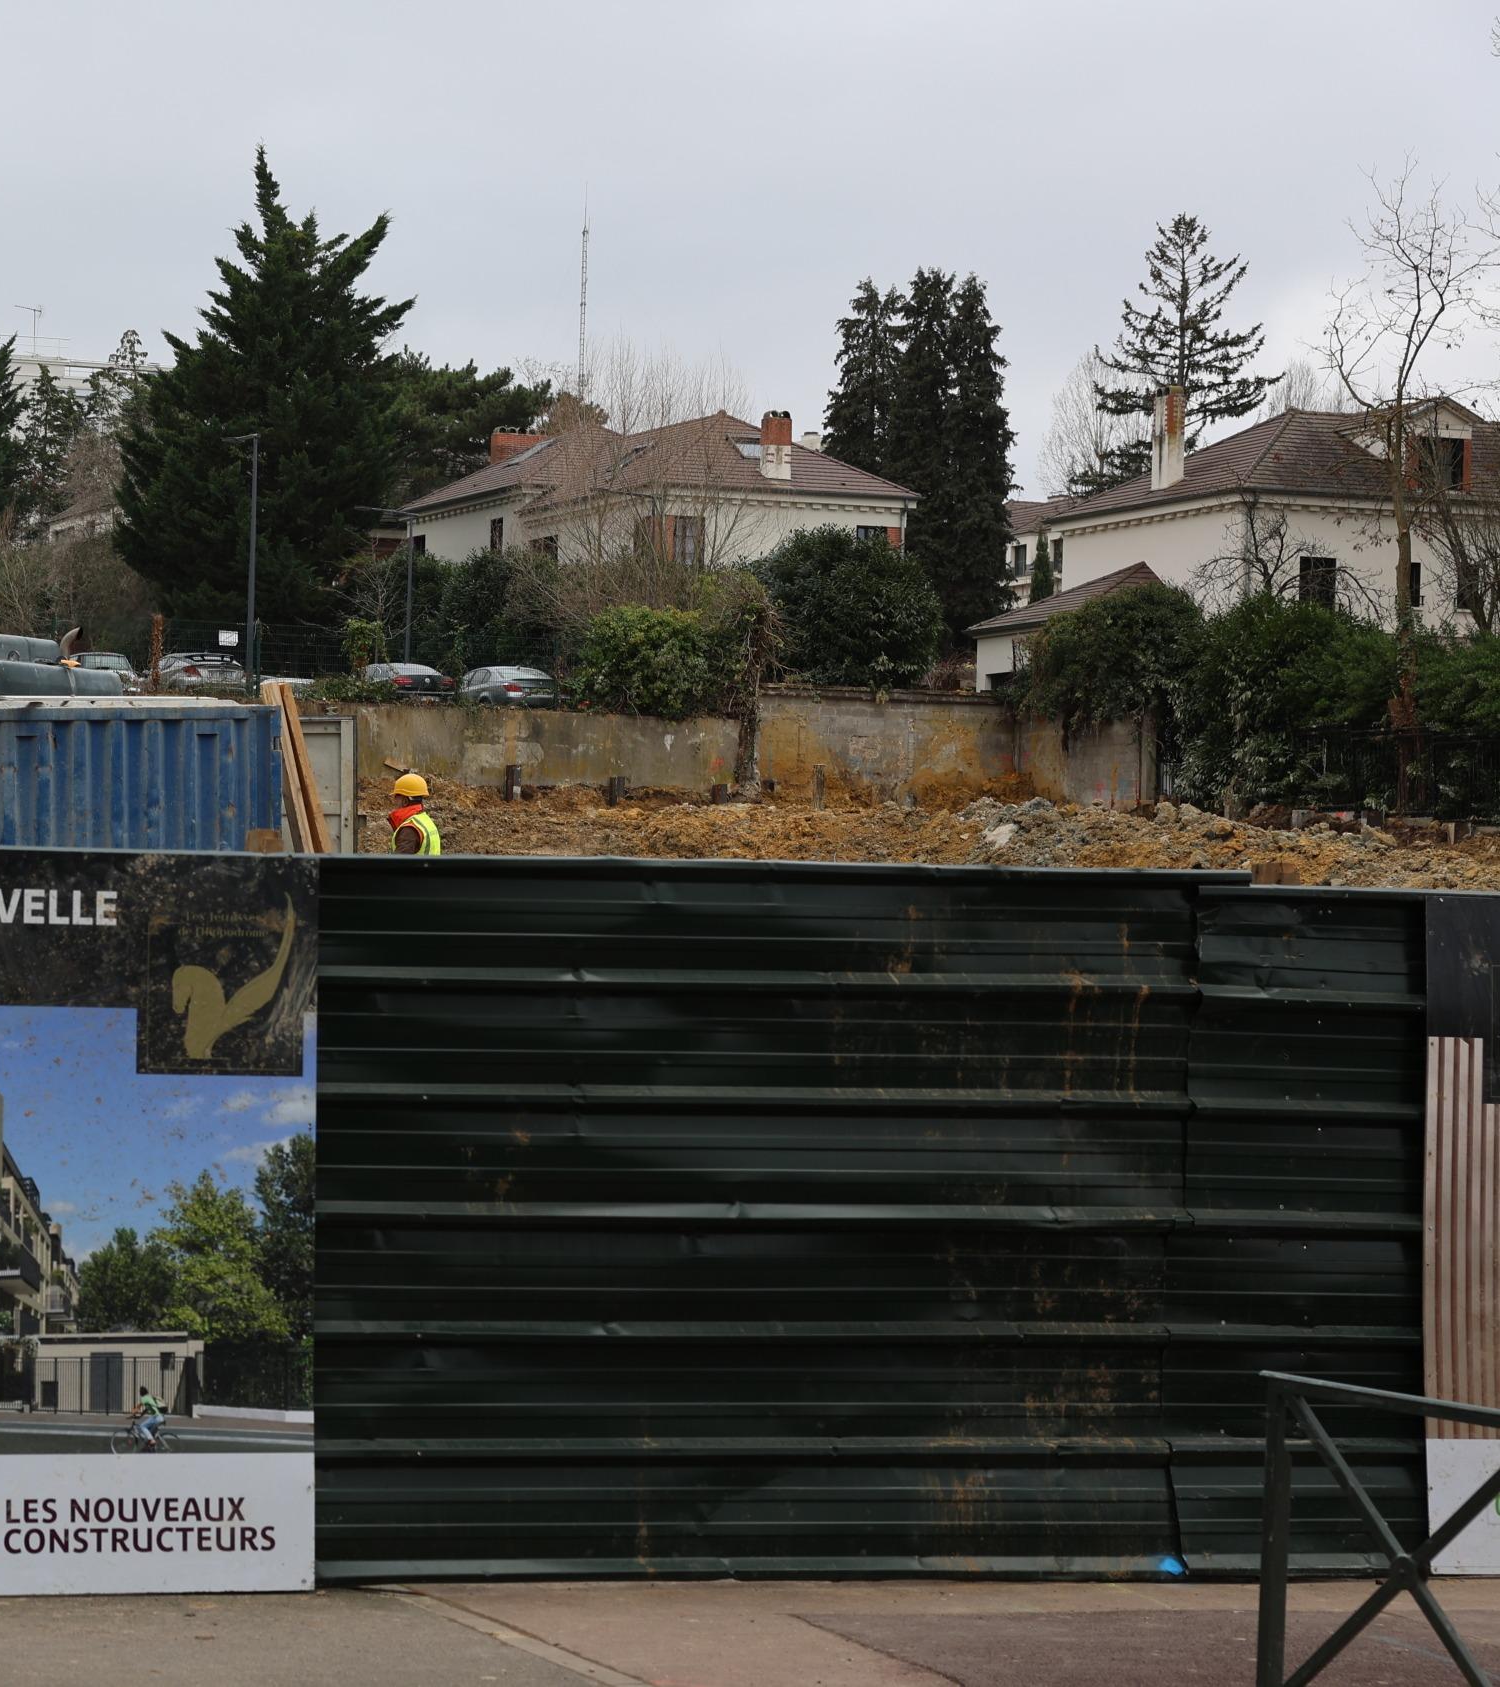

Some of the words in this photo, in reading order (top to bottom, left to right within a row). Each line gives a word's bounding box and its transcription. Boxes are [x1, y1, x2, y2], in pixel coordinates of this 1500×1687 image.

[5, 1498, 58, 1524] LES
[70, 1497, 246, 1523] NOUVEAUX
[3, 1525, 277, 1555] CONSTRUCTEURS
